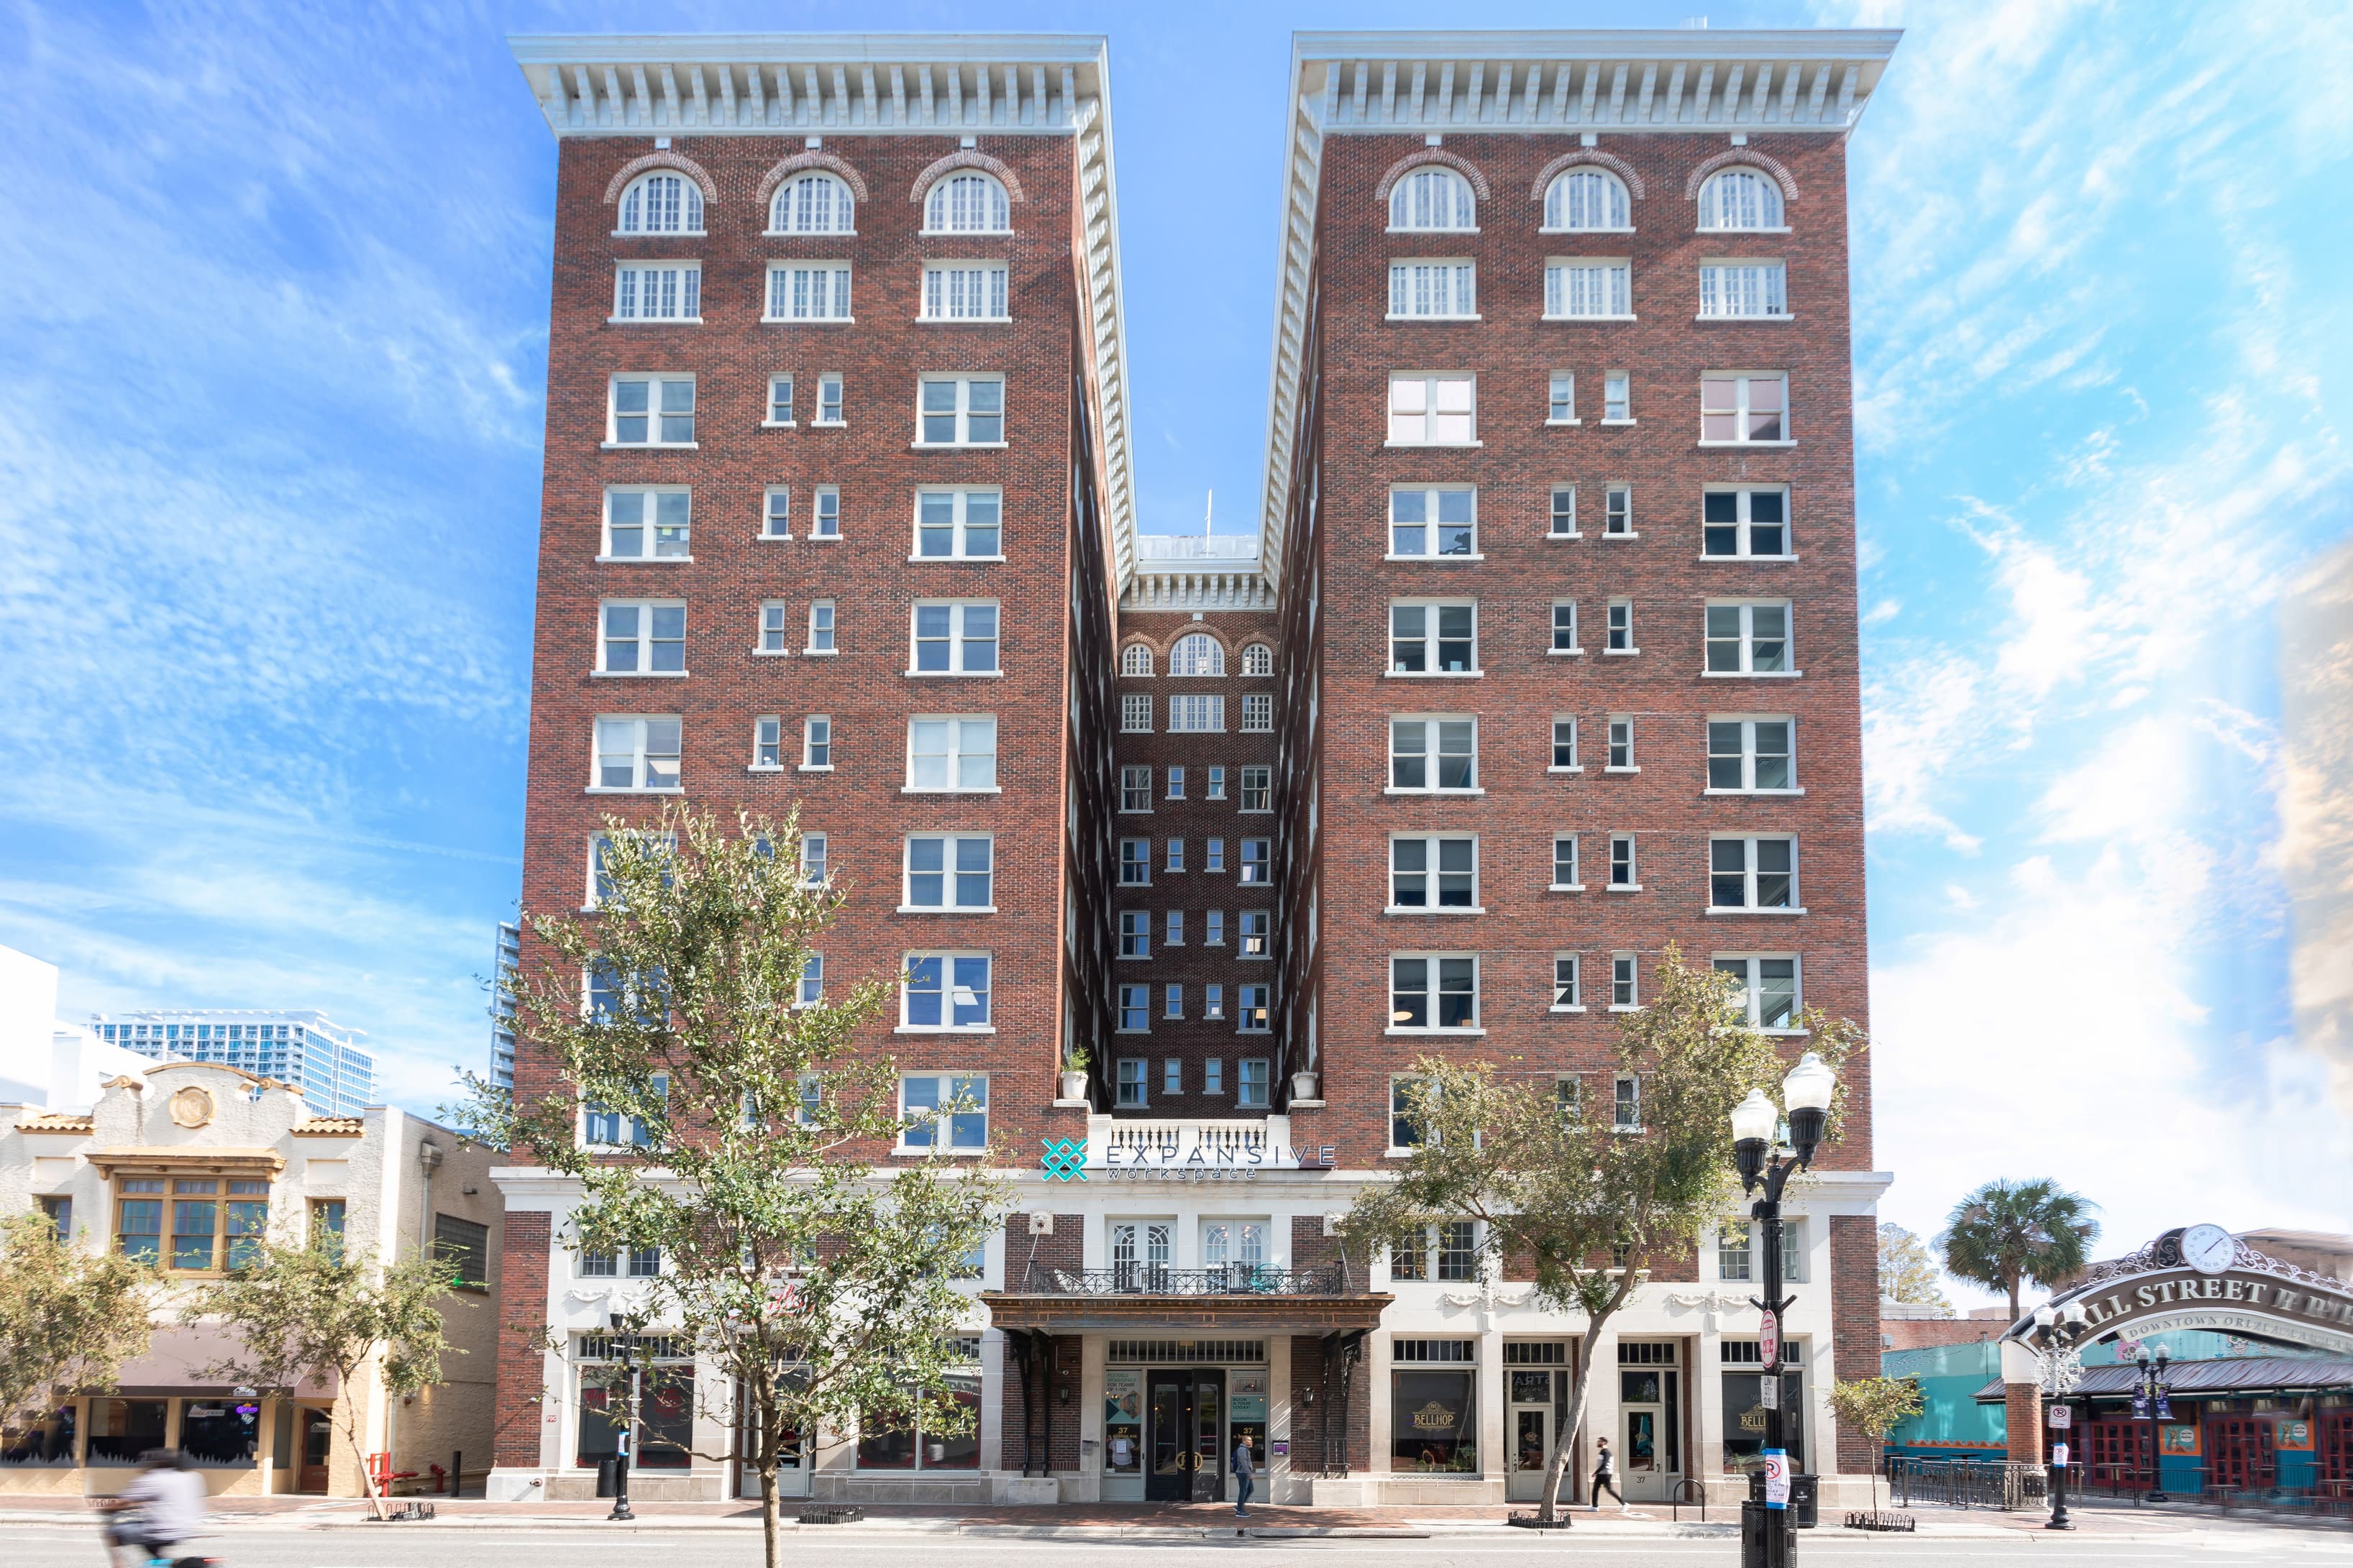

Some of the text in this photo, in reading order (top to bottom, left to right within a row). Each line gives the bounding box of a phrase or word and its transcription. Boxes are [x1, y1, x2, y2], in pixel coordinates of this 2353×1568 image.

[1106, 1145, 1336, 1165] EXPANSIVE
[1106, 1167, 1256, 1183] workspace
[2135, 1279, 2267, 1307] STREET
[2129, 1316, 2218, 1338] DOWNTOWN
[1415, 1414, 1454, 1426] BELLHOP
